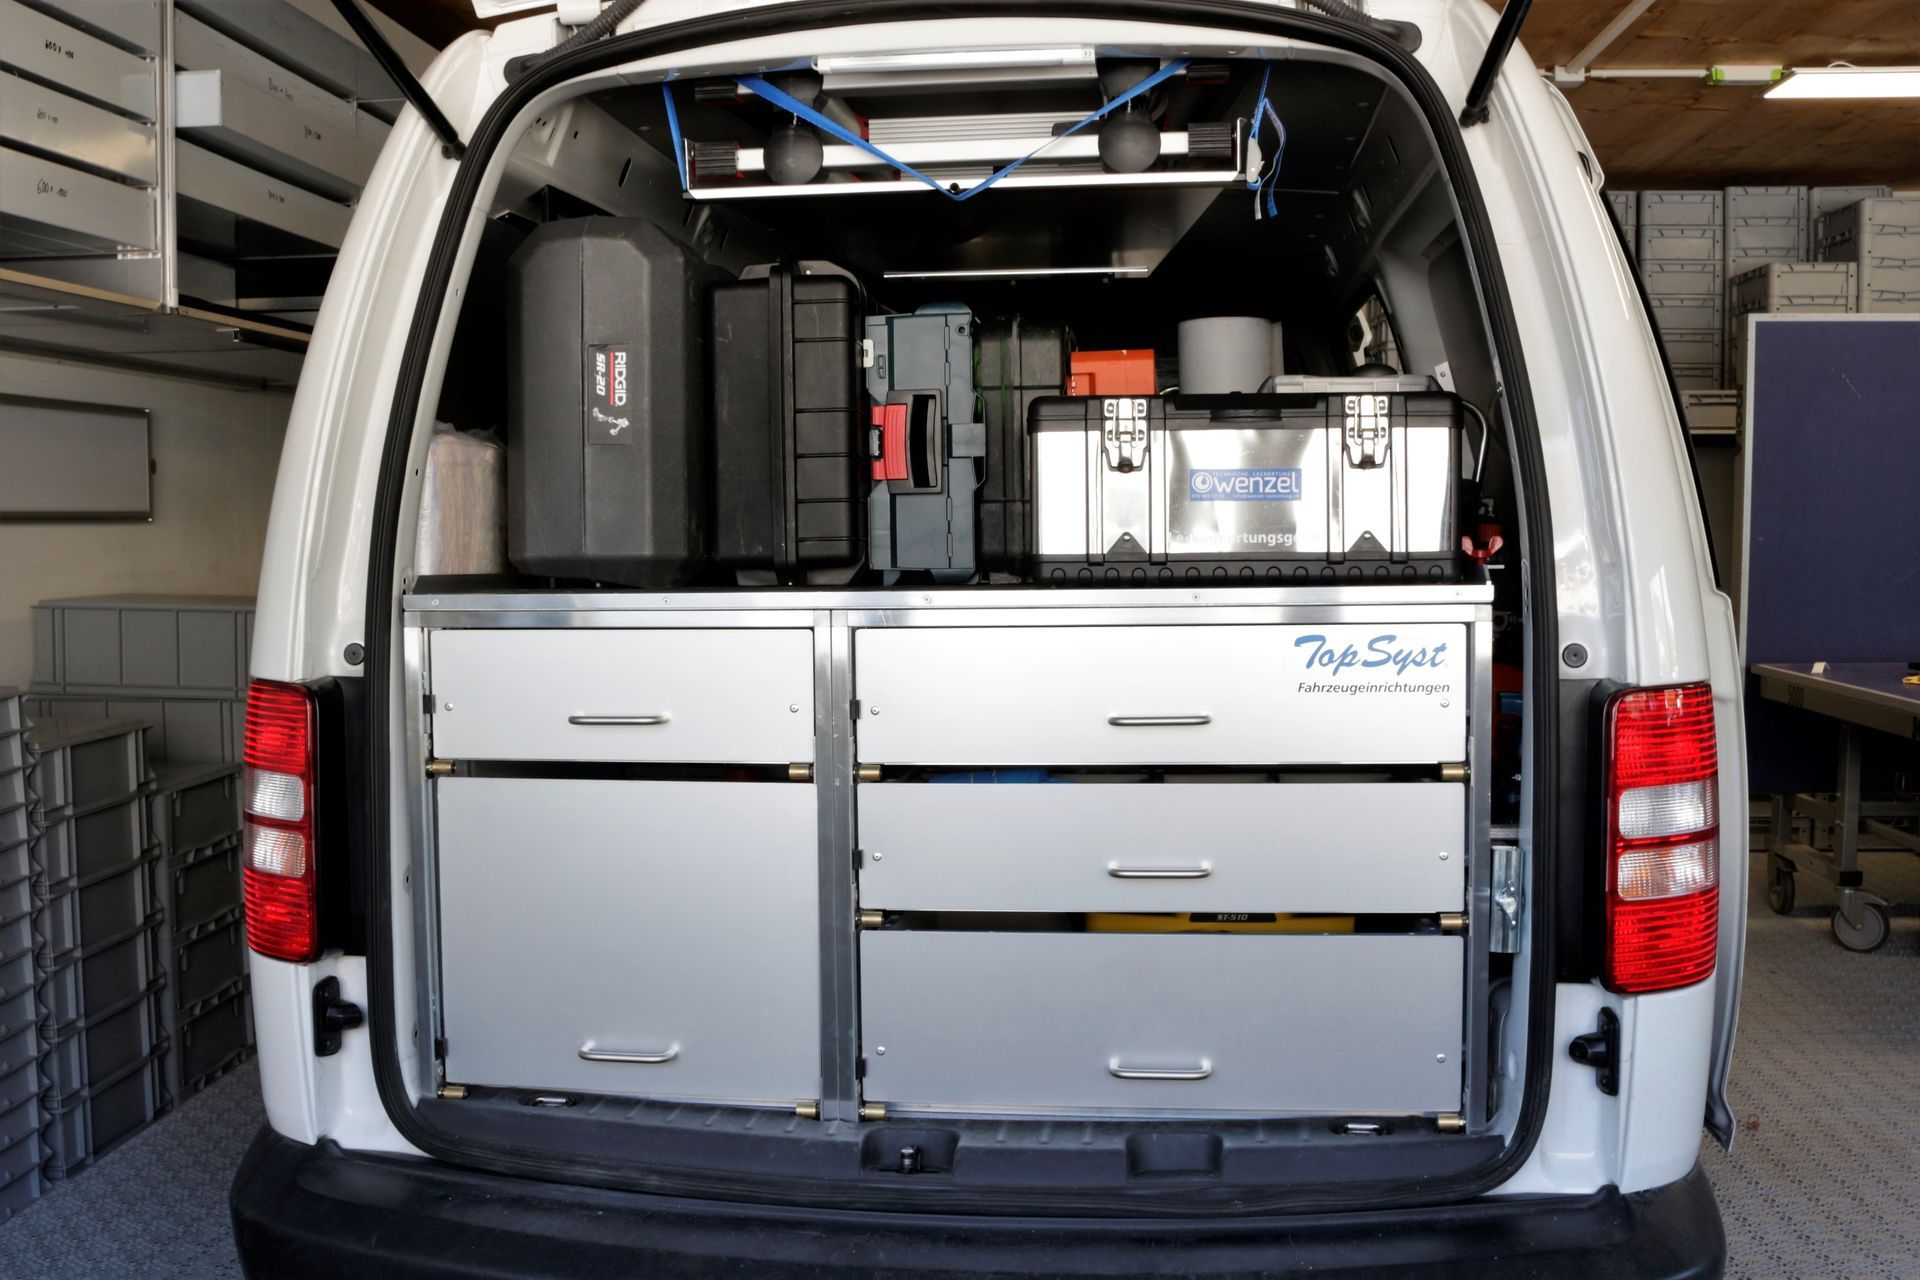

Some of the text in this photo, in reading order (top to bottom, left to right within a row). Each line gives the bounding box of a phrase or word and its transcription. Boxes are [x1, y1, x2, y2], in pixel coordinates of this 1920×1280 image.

[596, 352, 606, 396] SR-20
[614, 351, 627, 406] RIDGID
[1213, 471, 1300, 493] wenzel
[1297, 681, 1450, 695] Fahrzeugeinrichtungen
[1217, 913, 1248, 921] ST-510
